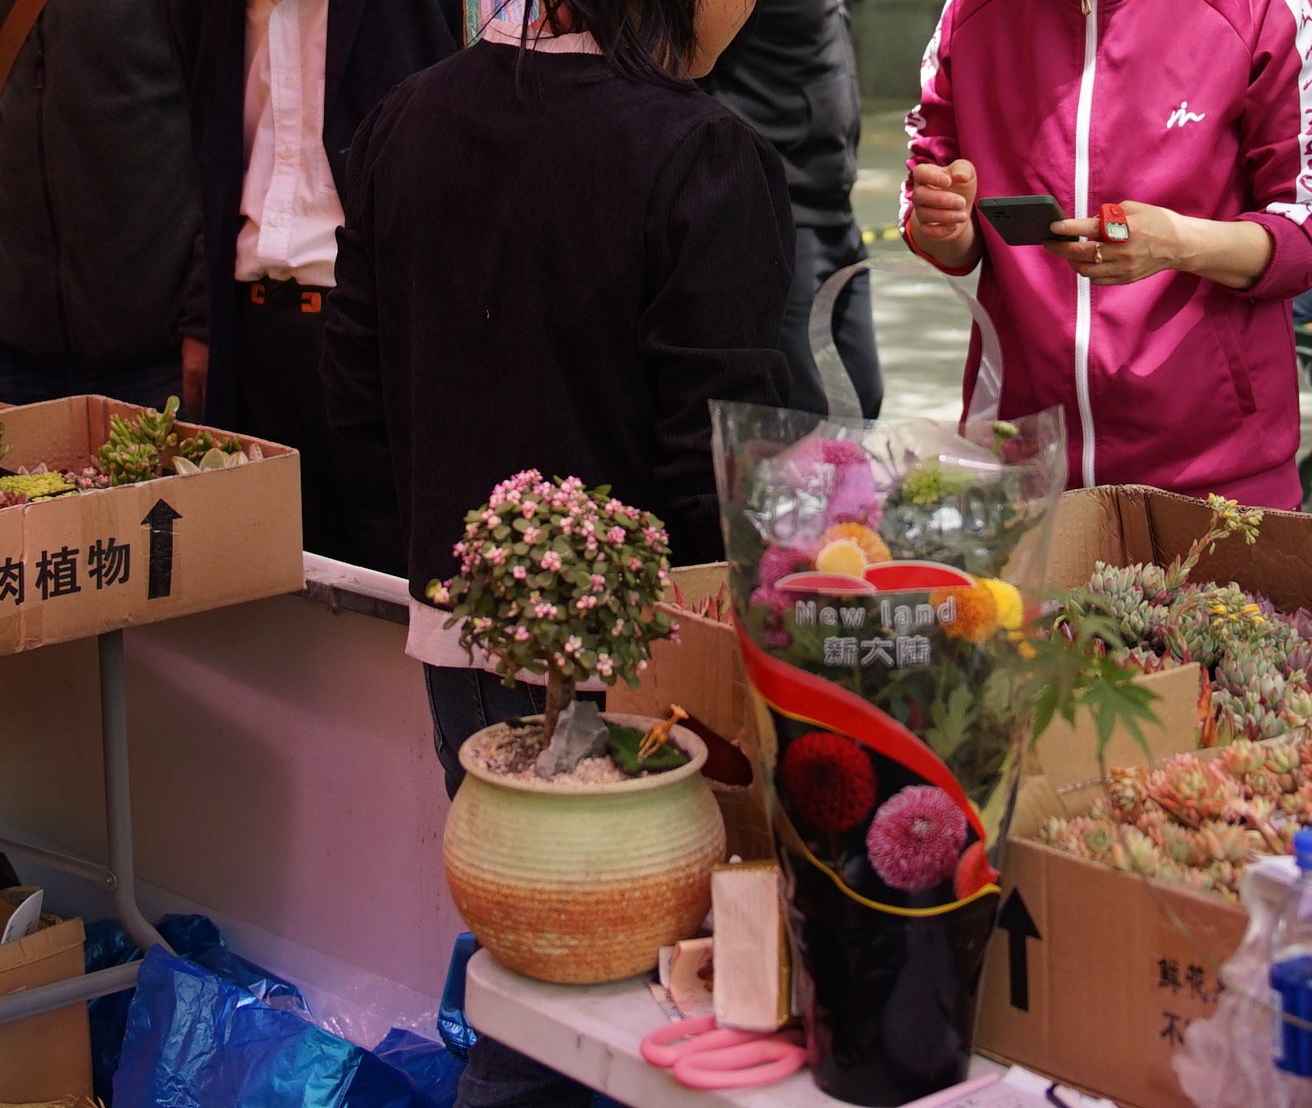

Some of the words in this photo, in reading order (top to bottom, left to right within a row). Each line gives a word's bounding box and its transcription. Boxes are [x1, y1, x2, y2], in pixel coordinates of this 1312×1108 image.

[795, 600, 866, 628] New
[880, 595, 957, 628] land
[823, 634, 932, 668] 新大陆
